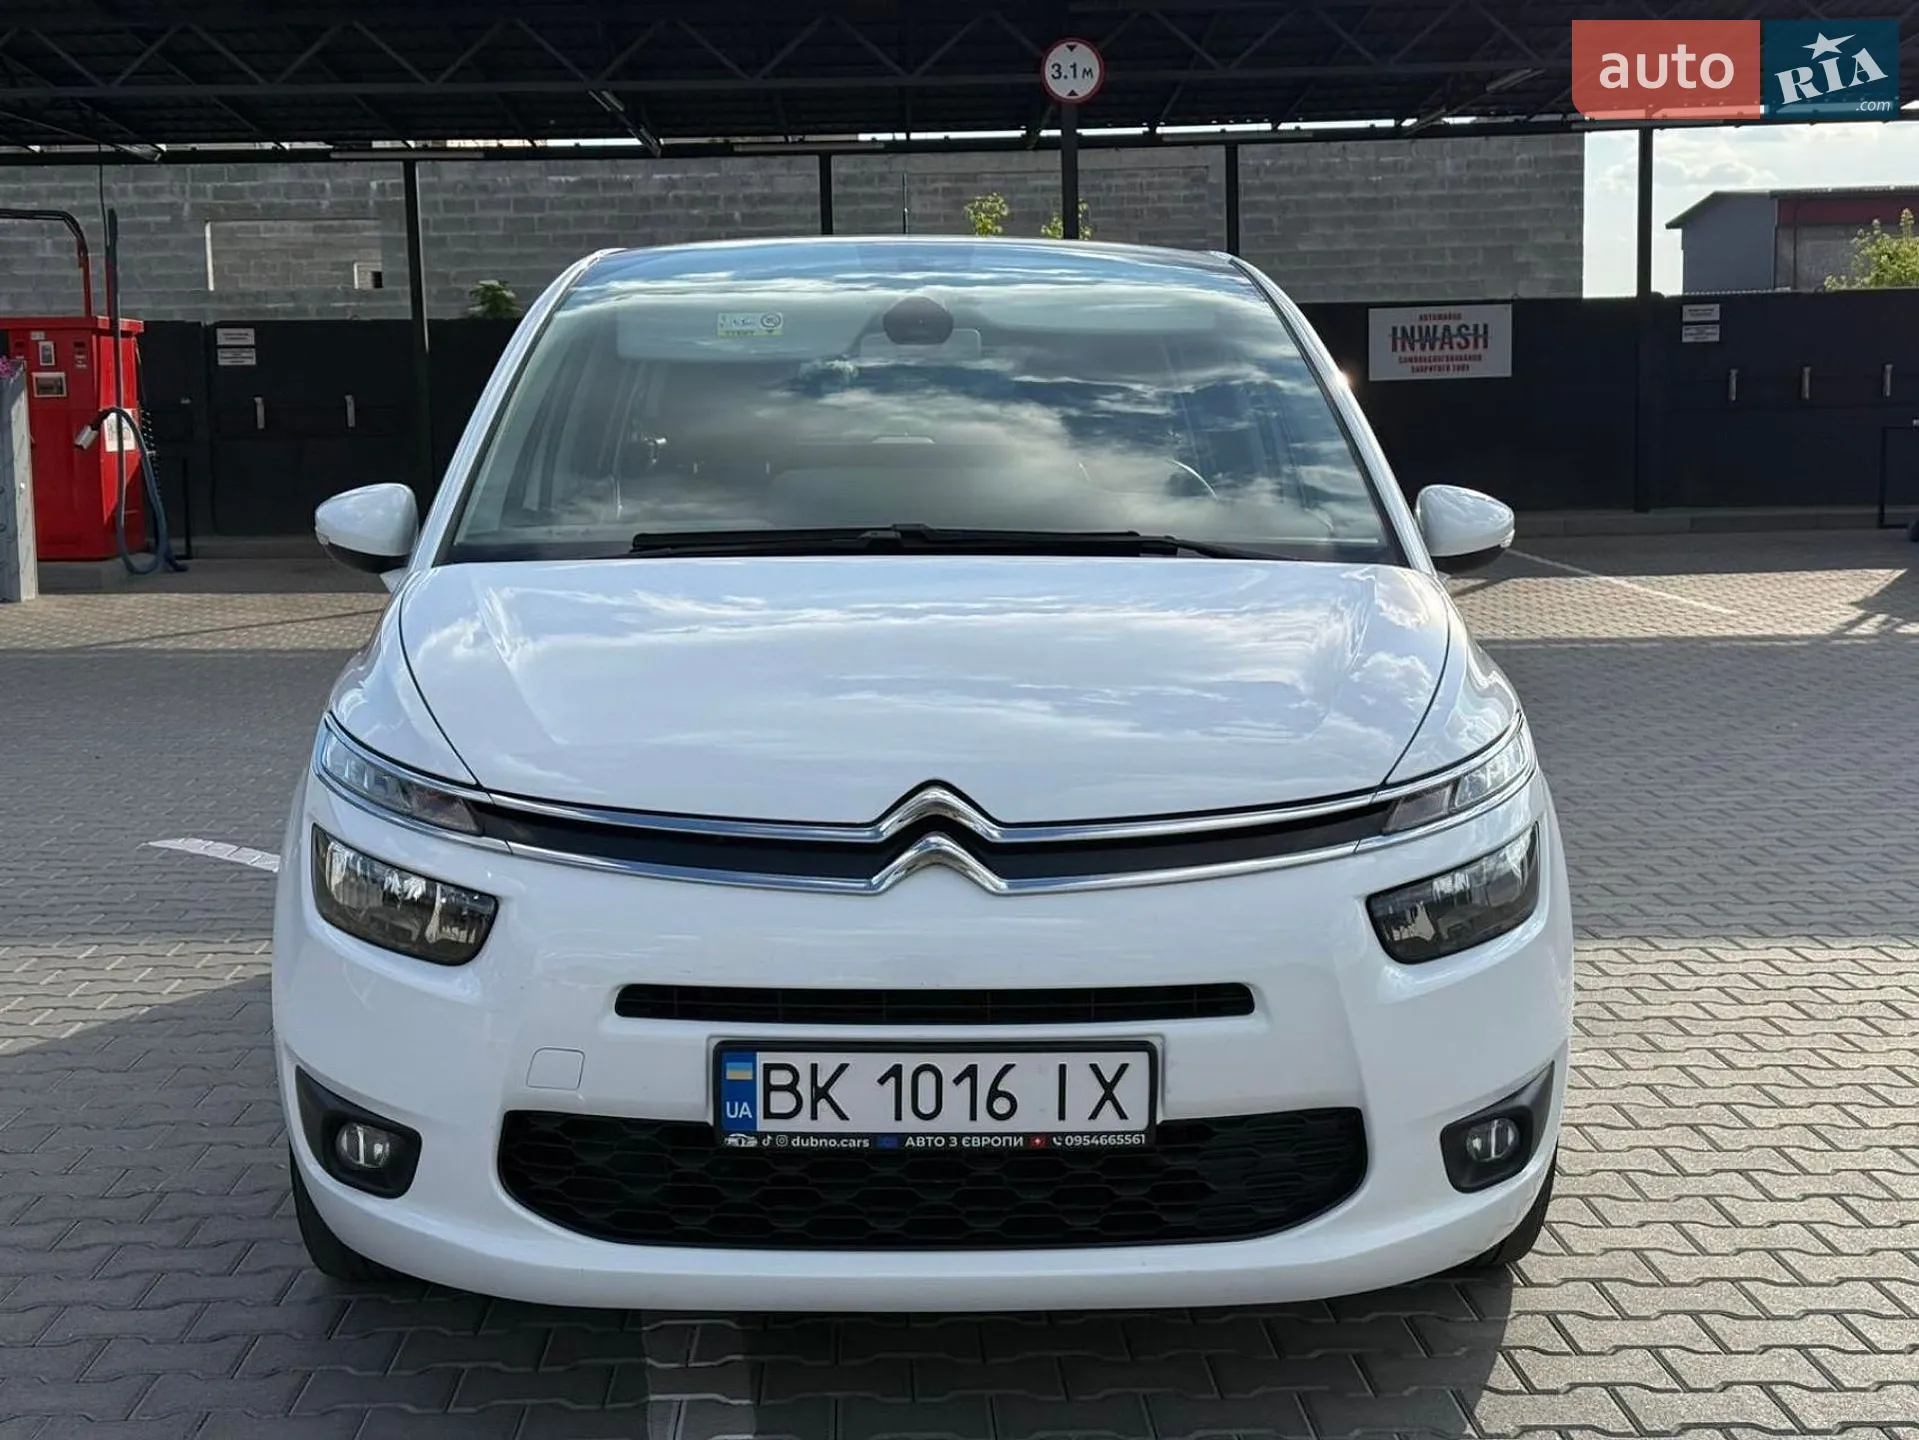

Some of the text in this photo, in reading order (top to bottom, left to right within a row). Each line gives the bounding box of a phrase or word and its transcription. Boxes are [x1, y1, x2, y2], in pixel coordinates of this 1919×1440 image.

[1051, 62, 1078, 80] 3.1
[1391, 323, 1489, 352] INWASH
[762, 1062, 850, 1121] BK
[877, 1062, 1018, 1121] 1016
[725, 1101, 753, 1119] UA
[791, 1136, 870, 1148] dubno.cars
[905, 1136, 946, 1148] АВТО
[962, 1136, 1024, 1147] ЄВРОПИ
